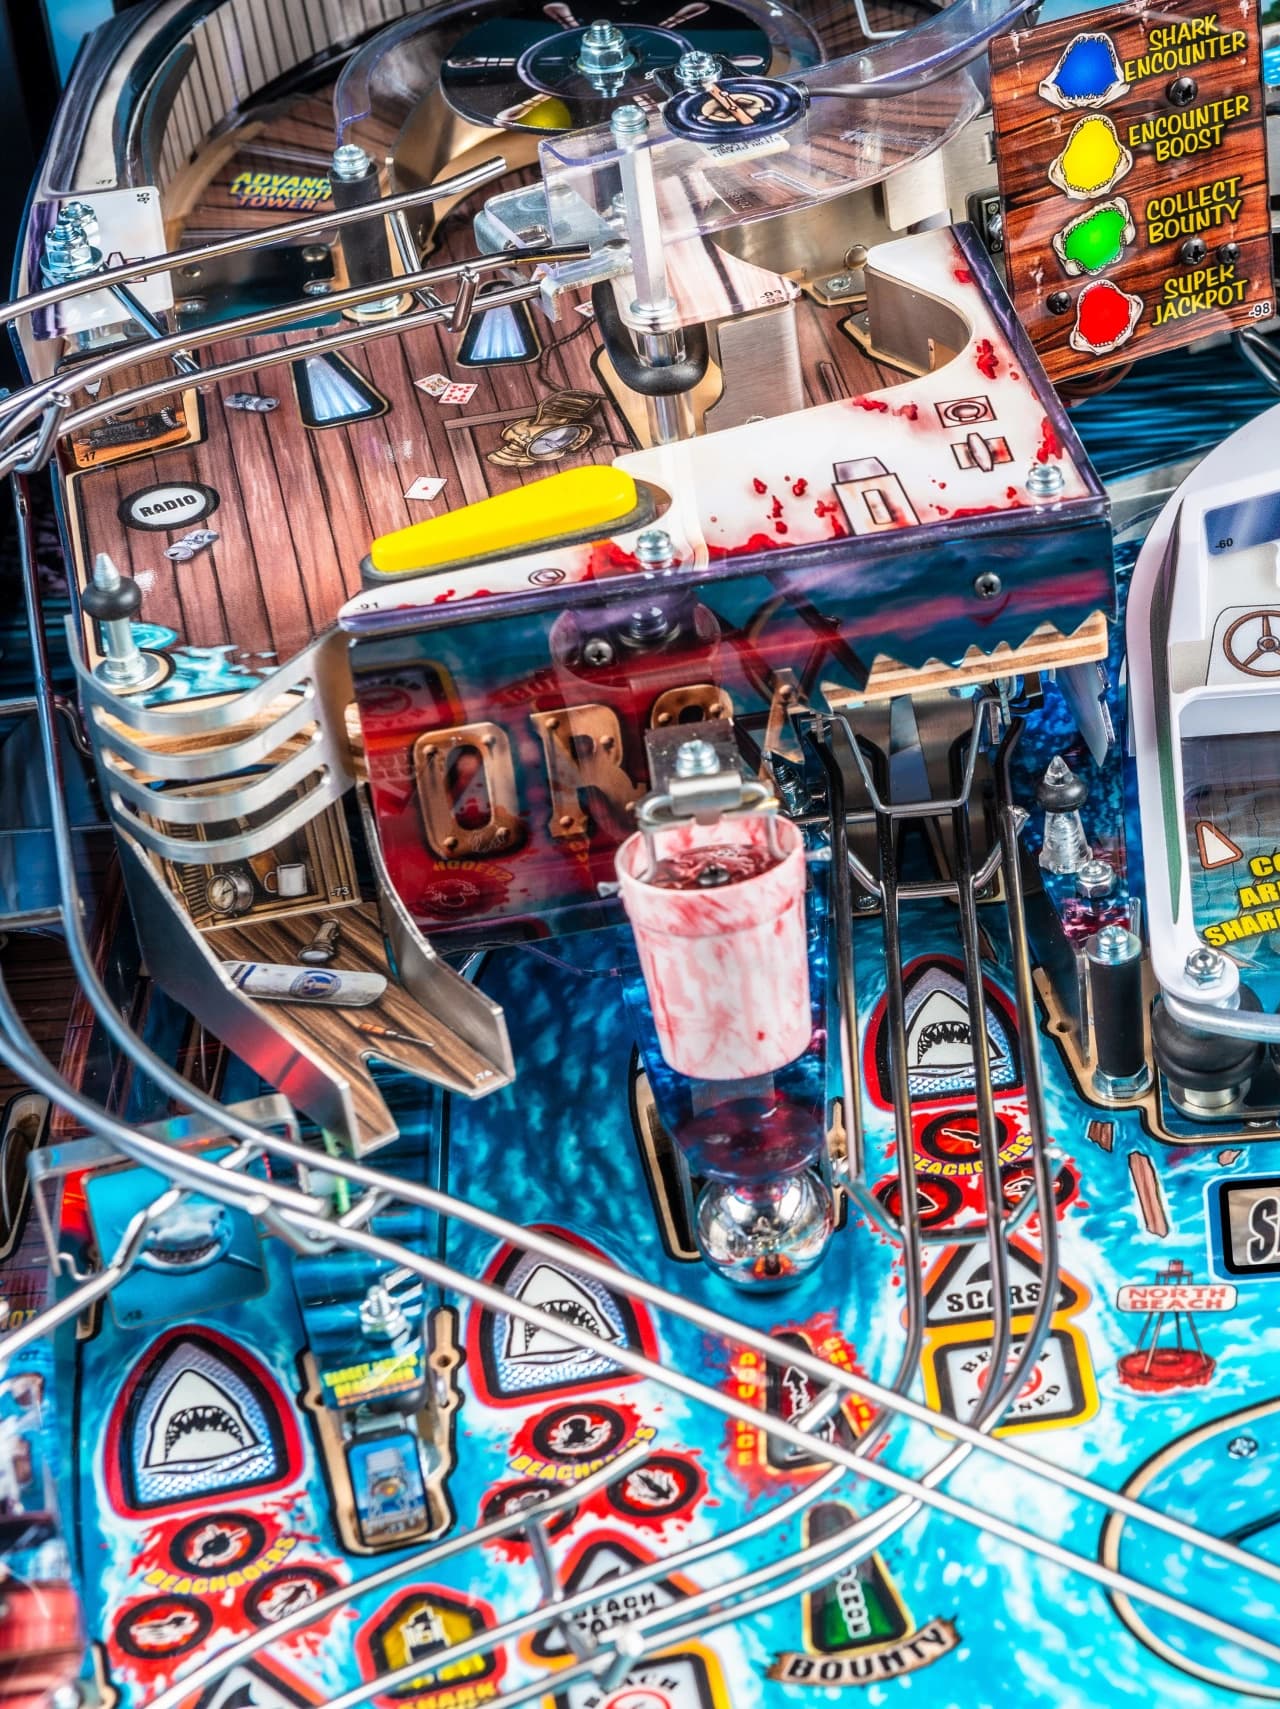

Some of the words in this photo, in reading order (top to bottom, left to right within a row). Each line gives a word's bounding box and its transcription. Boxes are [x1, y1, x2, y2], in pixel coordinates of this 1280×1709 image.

[1149, 15, 1219, 52] SHARK
[1124, 31, 1247, 83] ENCOUNTER
[1128, 95, 1249, 148] ENCOUNTER
[1156, 124, 1226, 163] BOOST
[231, 172, 331, 190] ADVANC
[237, 195, 318, 210] TOWER
[1146, 176, 1241, 221] COLLECT
[1149, 200, 1242, 244] BOUNTY
[1152, 280, 1248, 326] JACKPOT
[1249, 302, 1271, 318] -98
[79, 451, 97, 463] -17
[139, 494, 198, 518] RADIO
[1215, 537, 1234, 549] -60
[947, 1283, 1042, 1313] SCRS
[1128, 1288, 1226, 1299] NORTH
[1130, 1299, 1223, 1310] BEACH
[145, 1537, 297, 1594] BEACHGOERS
[787, 1626, 948, 1681] BOUNTY
